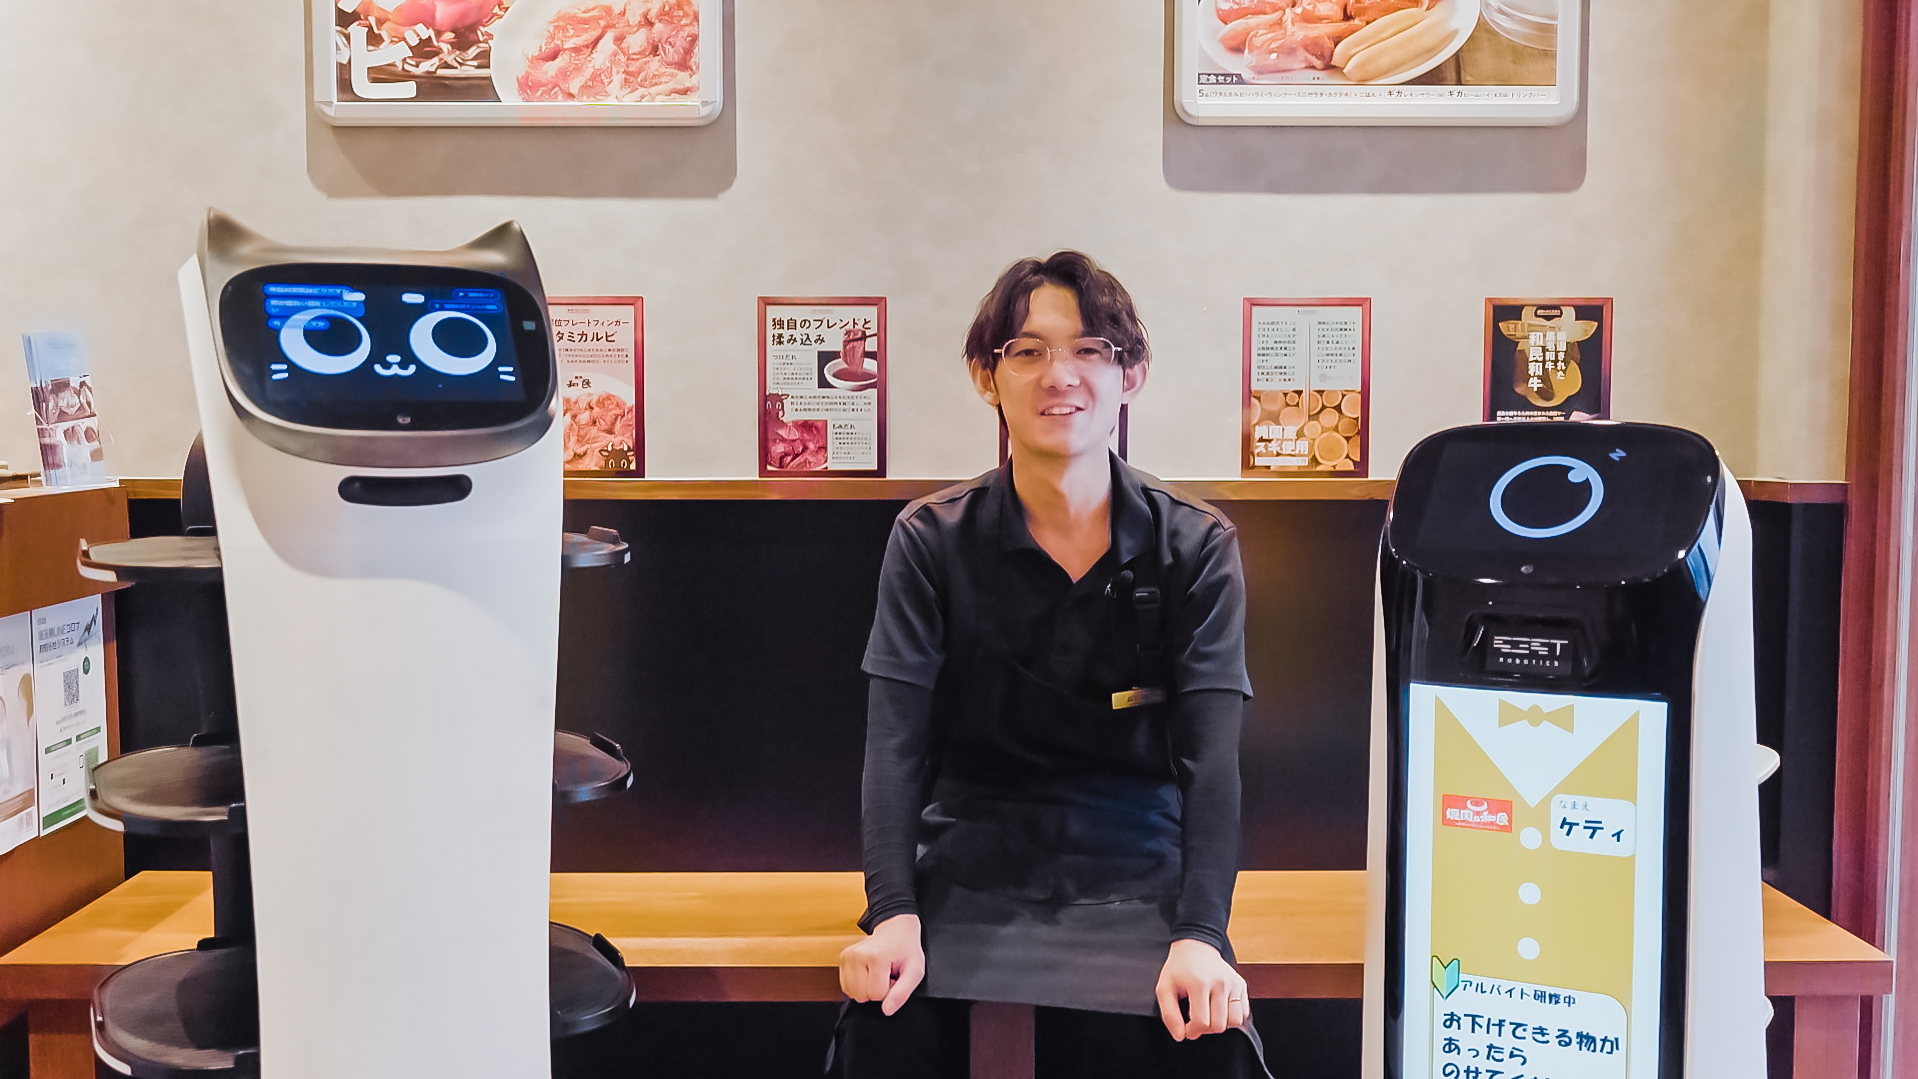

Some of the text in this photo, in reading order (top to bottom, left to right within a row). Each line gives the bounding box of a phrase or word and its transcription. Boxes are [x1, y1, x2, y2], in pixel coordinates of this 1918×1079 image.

[338, 0, 430, 98] ビ
[771, 317, 872, 330] 独自のブレンドと
[771, 333, 826, 346] 揉み込み
[1558, 800, 1591, 811] なまえ
[1559, 816, 1625, 843] ケティ
[1461, 980, 1577, 1007] アルバイト研修中
[1442, 1036, 1528, 1066] あったら
